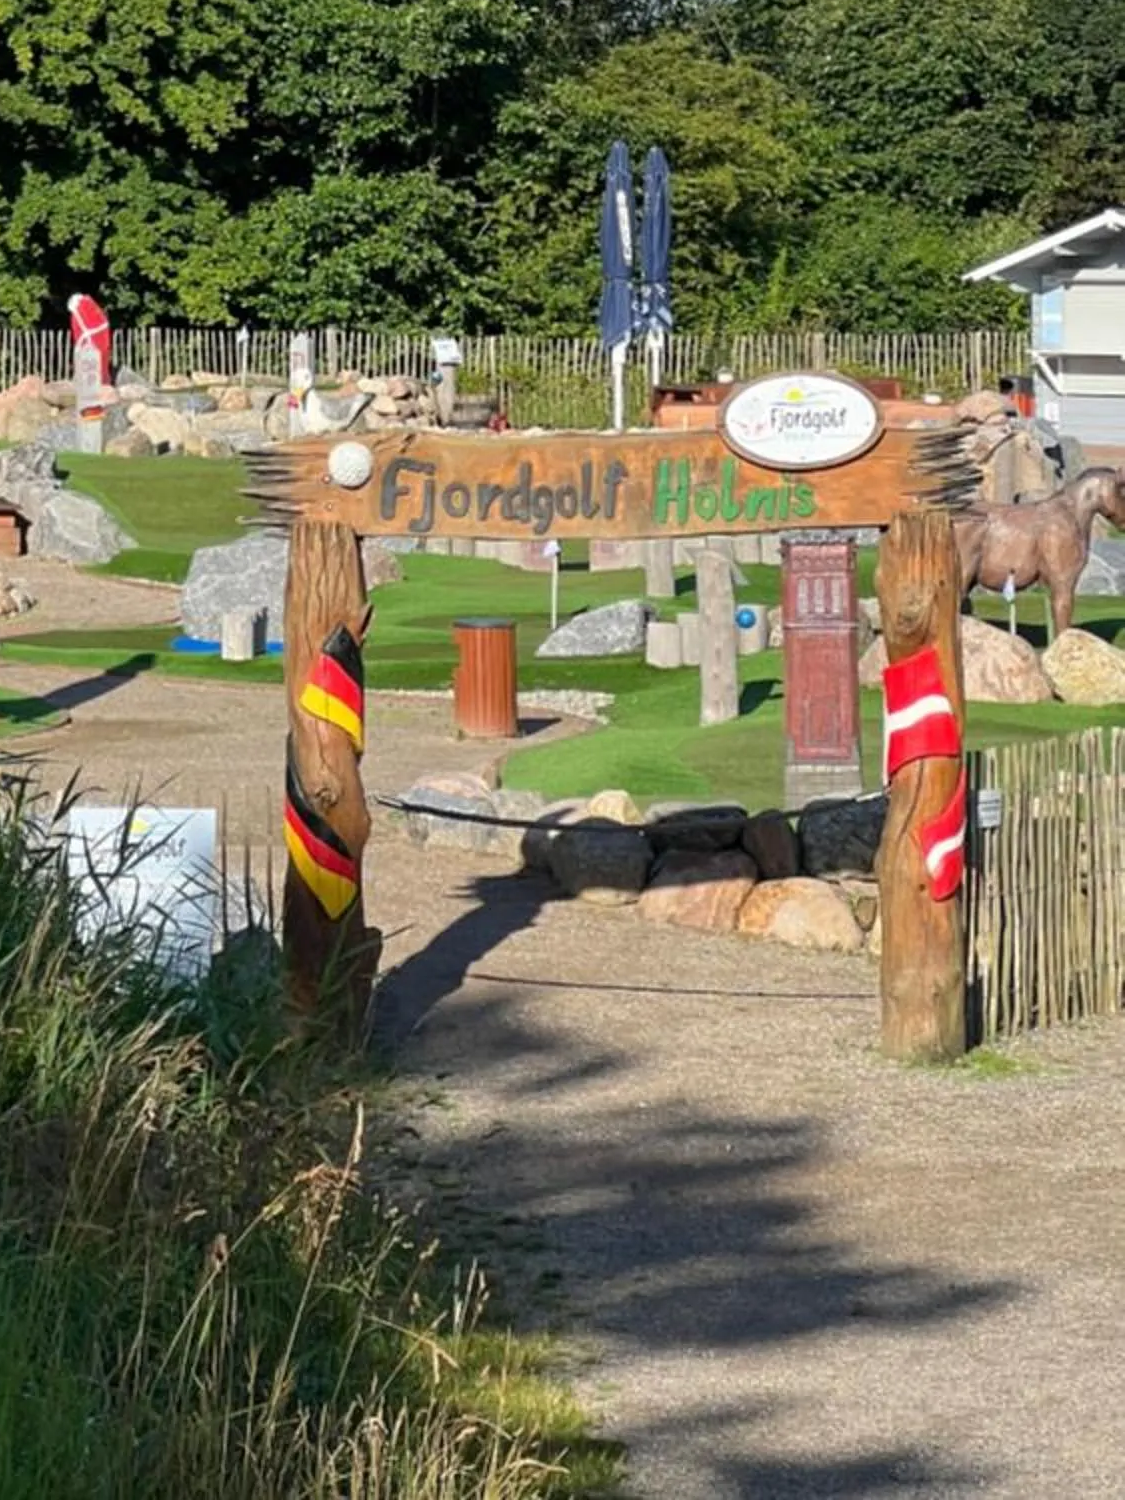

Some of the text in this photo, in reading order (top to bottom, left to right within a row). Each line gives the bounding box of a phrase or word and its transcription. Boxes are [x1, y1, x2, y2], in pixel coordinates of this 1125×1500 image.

[770, 408, 847, 434] Fjordgolf
[380, 455, 817, 533] Fjordgolf Holnis
